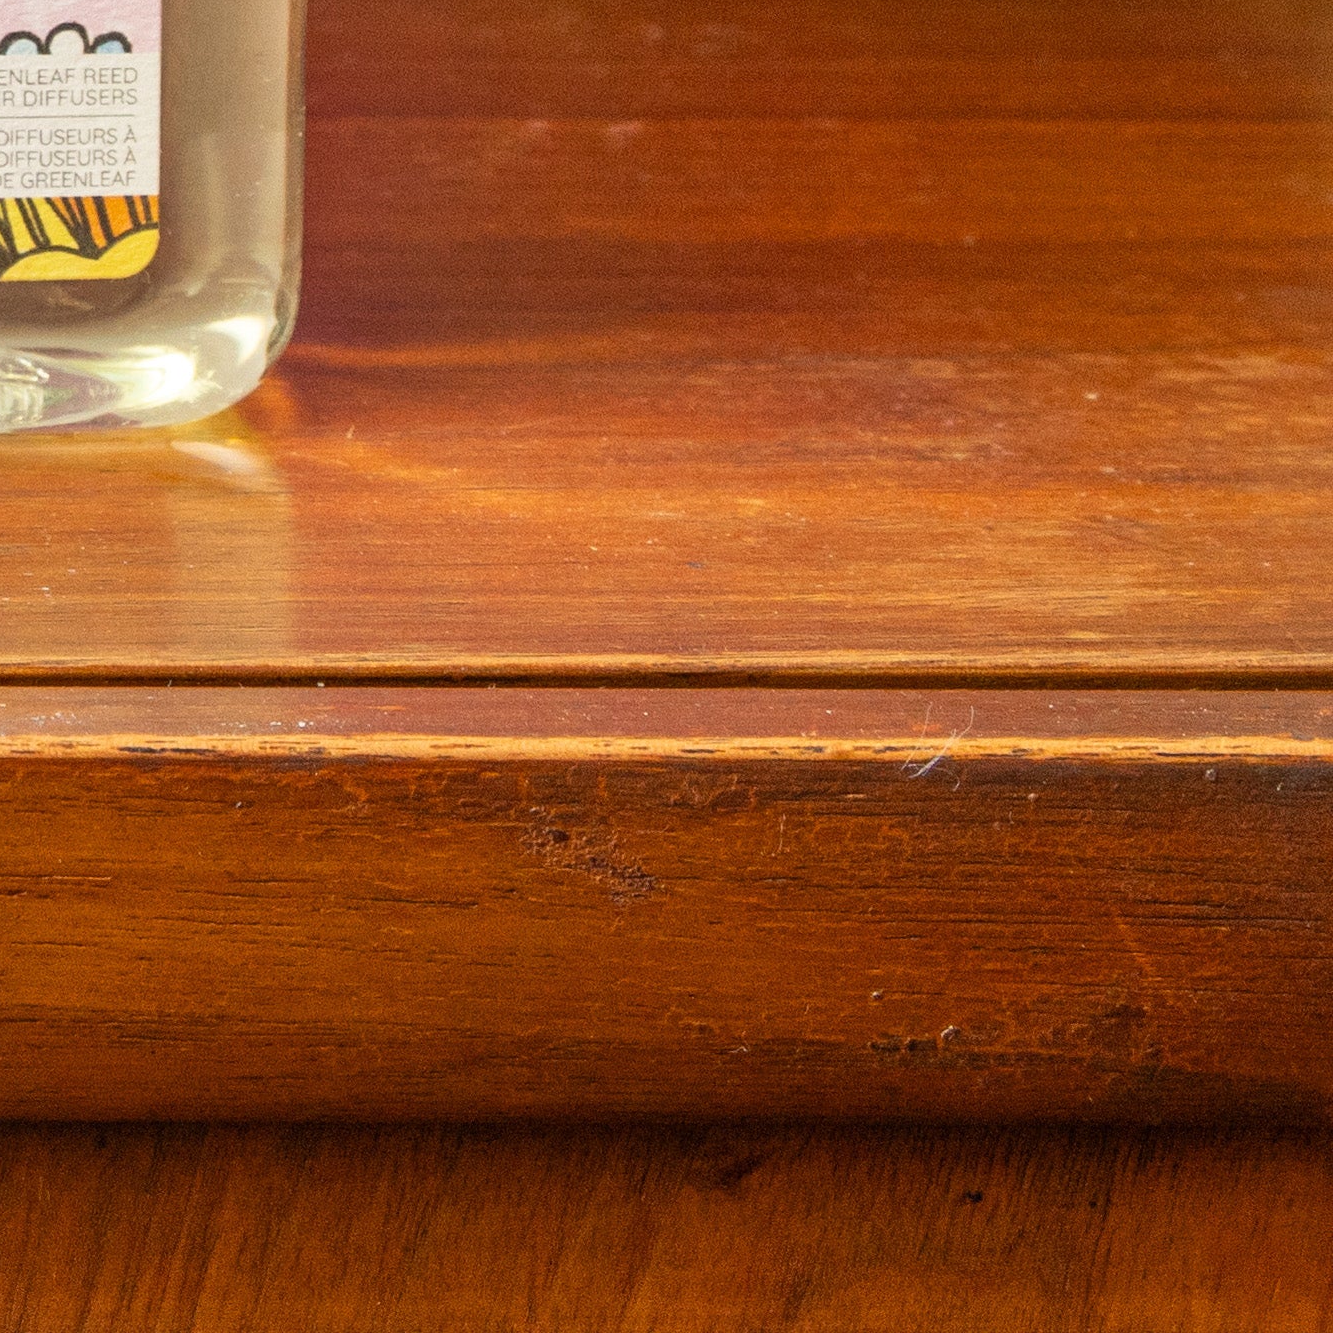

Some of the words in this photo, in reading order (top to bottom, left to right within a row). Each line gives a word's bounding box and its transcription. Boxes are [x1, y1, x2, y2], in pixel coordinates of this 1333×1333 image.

[83, 67, 138, 84] REED
[23, 88, 138, 107] DIFFUSERS
[20, 170, 136, 190] GREENLEAF
